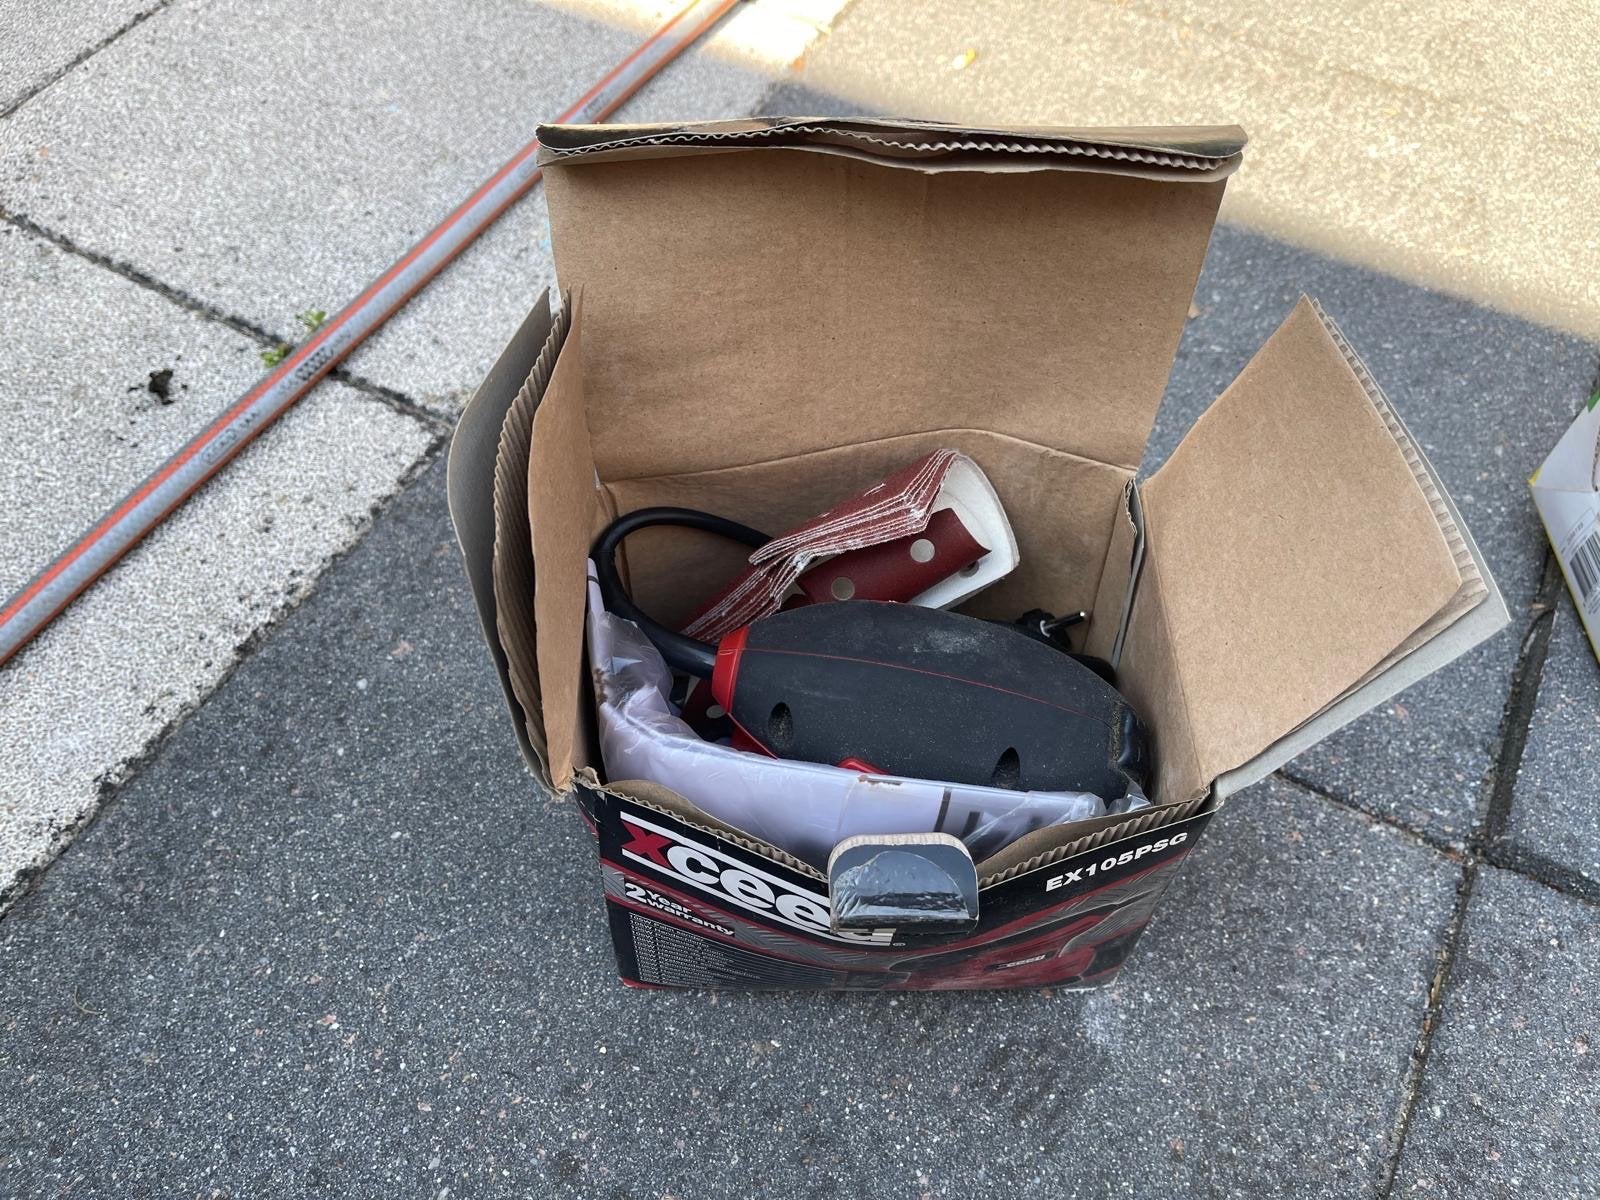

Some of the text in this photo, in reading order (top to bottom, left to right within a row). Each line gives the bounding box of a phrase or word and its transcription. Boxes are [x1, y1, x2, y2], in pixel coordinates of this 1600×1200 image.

[1045, 832, 1188, 891] EX105PSG
[625, 882, 646, 904] 2
[646, 890, 692, 914] Year
